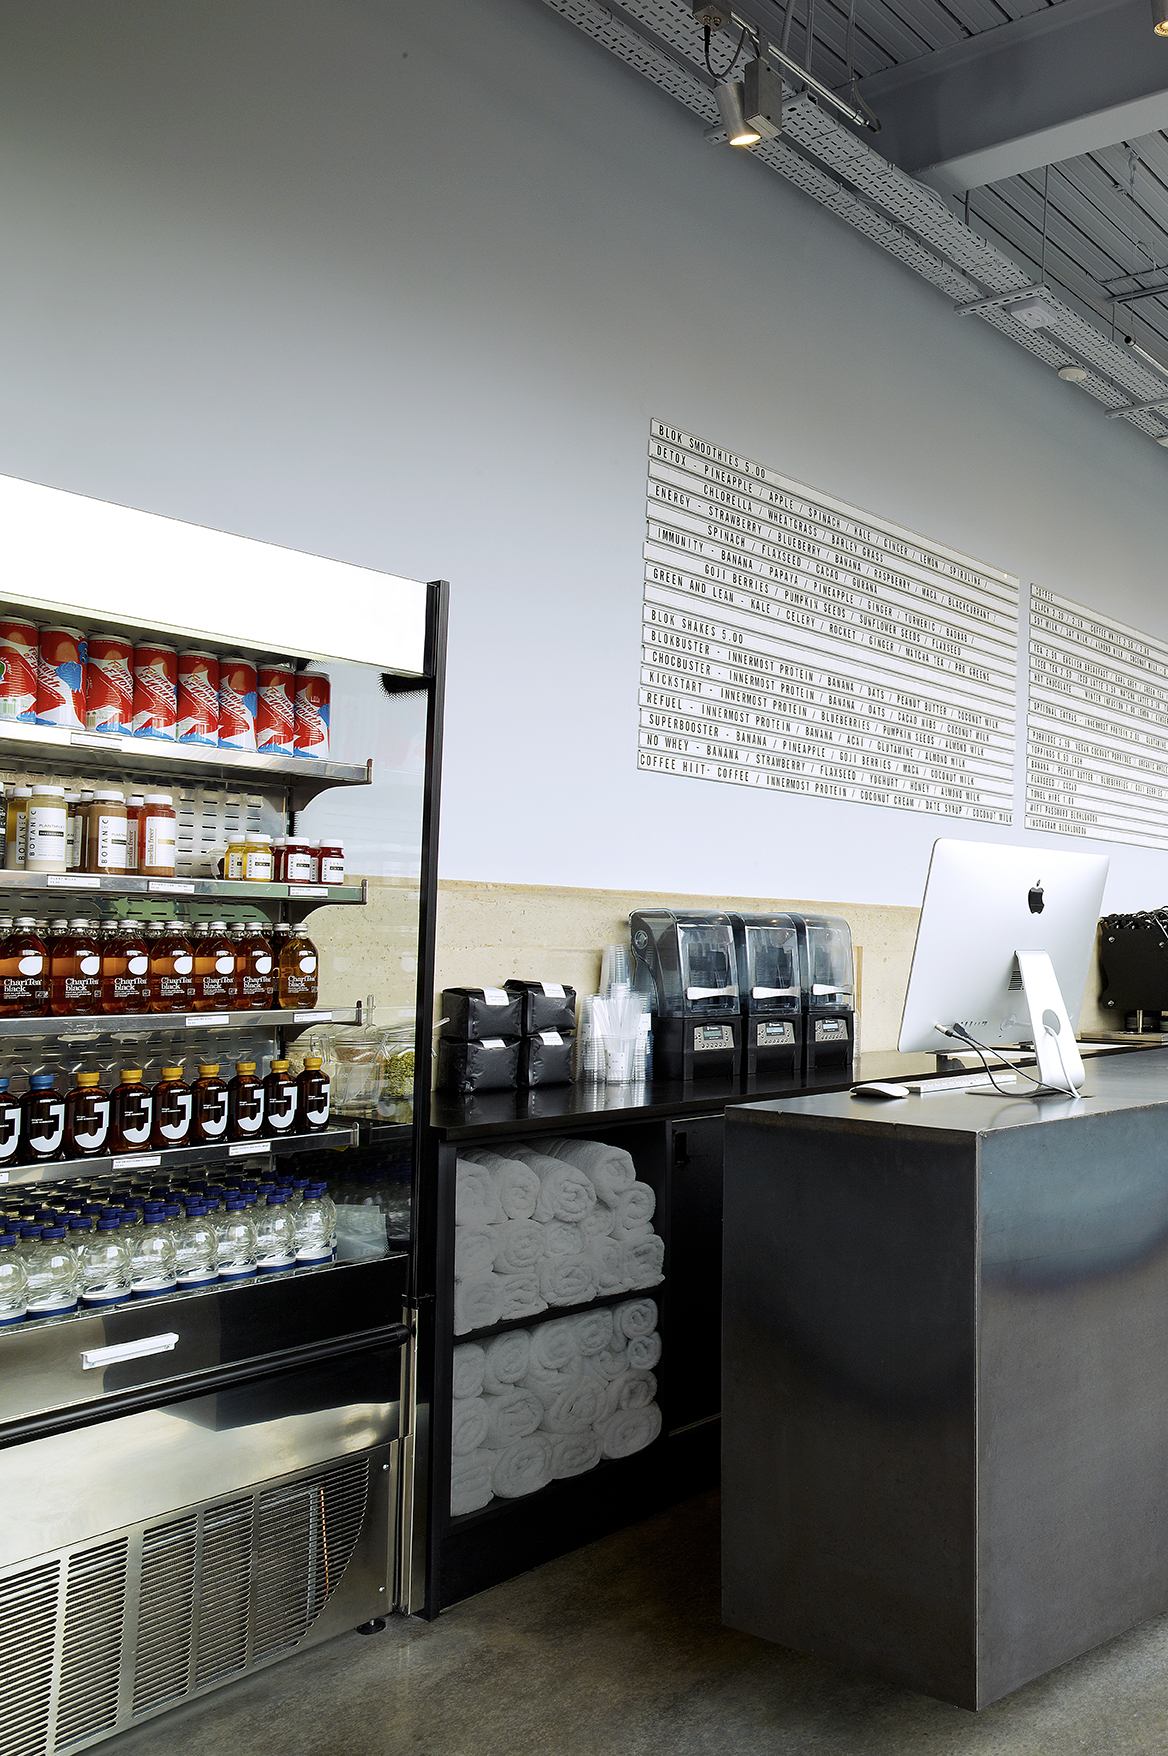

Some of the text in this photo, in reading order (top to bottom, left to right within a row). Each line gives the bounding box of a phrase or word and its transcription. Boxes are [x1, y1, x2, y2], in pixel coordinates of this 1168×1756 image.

[659, 424, 765, 479] BLOK SMOOTHIES 5.00
[655, 485, 689, 507] ENERGY
[708, 505, 761, 534] STRAWBERRY
[777, 531, 820, 556] BLUEBERRY
[835, 553, 860, 571] BANANA
[873, 568, 910, 590] RASPBERRY
[656, 444, 686, 466] DETOX
[704, 464, 752, 493] PINEAPPLE
[769, 490, 793, 510] APPLE
[808, 507, 840, 529] SPINACH
[883, 538, 907, 556] GINGER
[703, 483, 883, 563] CHLORELLA WHEATGRASS BARLEY GRASS
[658, 527, 703, 553] IMMUNITY
[721, 549, 752, 570] BANANA
[769, 566, 798, 585] PAPAYA
[813, 581, 853, 604] PINEAPPLE
[867, 600, 892, 617] GINGER
[707, 524, 744, 547] SPINACH
[761, 544, 801, 567] FLAXSEED
[815, 563, 838, 580] CACAO
[651, 609, 743, 644] BLOK SHAKES 5.00
[653, 568, 682, 587] GREEN
[689, 579, 705, 594] AND
[712, 586, 733, 602] LEAN
[750, 598, 770, 614] KALE
[786, 609, 814, 627] CELERY
[829, 623, 855, 640] ROCKET
[868, 635, 893, 651] GINGER
[933, 656, 943, 667] TEA
[704, 563, 960, 656] GOJI BERRIES PUMPKIN SEEDS SUNFLOWER SEEDS FLAXSEED
[649, 670, 702, 693] KICKSTART
[720, 687, 766, 707] INNERMOST
[772, 699, 806, 716] PROTEIN
[821, 710, 870, 730] BLUEBERRIES
[915, 732, 934, 745] SEEDS
[651, 629, 946, 715] BLOKBUSTER INNERMOST PROTEIN BANANA OATS PEANUT BUTTER
[652, 650, 710, 675] CHOCBUSTER
[729, 669, 774, 690] INNERMOST
[780, 682, 814, 700] PROTEIN
[828, 694, 854, 710] BANANA
[868, 704, 885, 717] OATS
[897, 711, 917, 725] CACAO
[646, 692, 681, 709] REFUEL
[701, 704, 749, 723] INNERMOST
[755, 715, 790, 732] PROTEIN
[805, 726, 832, 741] BANANA
[846, 735, 863, 747] ACAI
[649, 713, 718, 737] SUPERBOOSTER
[736, 730, 766, 746] BANANA
[782, 740, 825, 757] PINEAPPLE
[839, 751, 856, 763] GOJI
[862, 755, 891, 770] BERRIES
[640, 753, 675, 770] COFFEE
[717, 766, 748, 782] COFFEE
[766, 774, 809, 791] INNERMOST
[814, 782, 846, 797] PROTEIN
[860, 790, 889, 803] COCONUT
[647, 733, 897, 787] NO WHEY BANANA STRAWBERRY FLAXSEED YOGHURT
[4, 978, 42, 986] ChariTea
